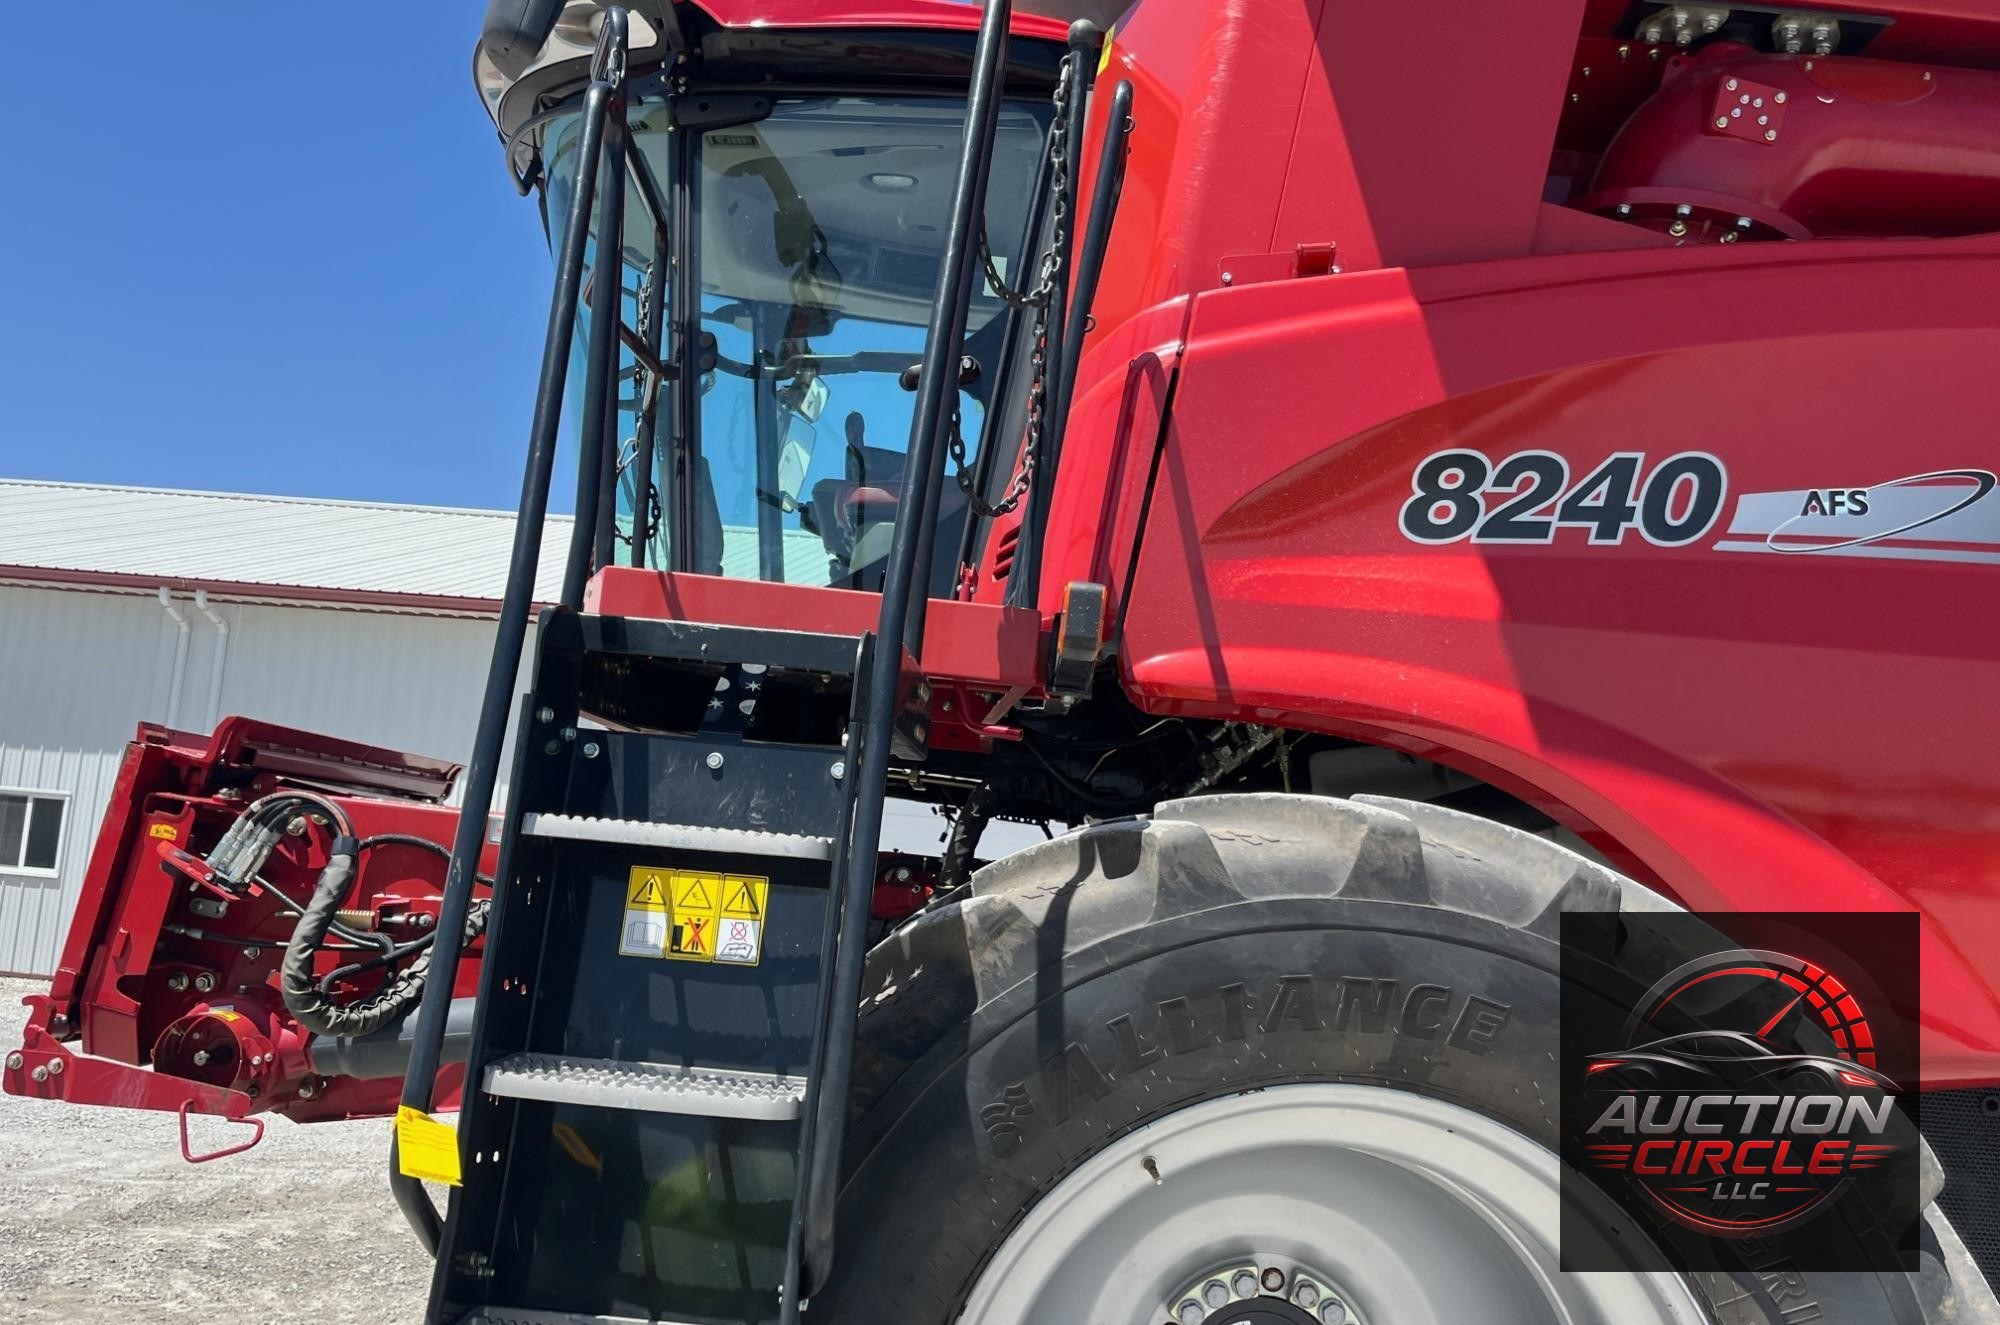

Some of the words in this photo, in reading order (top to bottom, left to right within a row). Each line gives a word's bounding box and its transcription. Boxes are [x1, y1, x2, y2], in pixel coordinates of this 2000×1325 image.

[1399, 449, 1727, 547] 8240
[1801, 489, 1870, 516] AFS
[1046, 974, 1511, 1126] ALLIANCE
